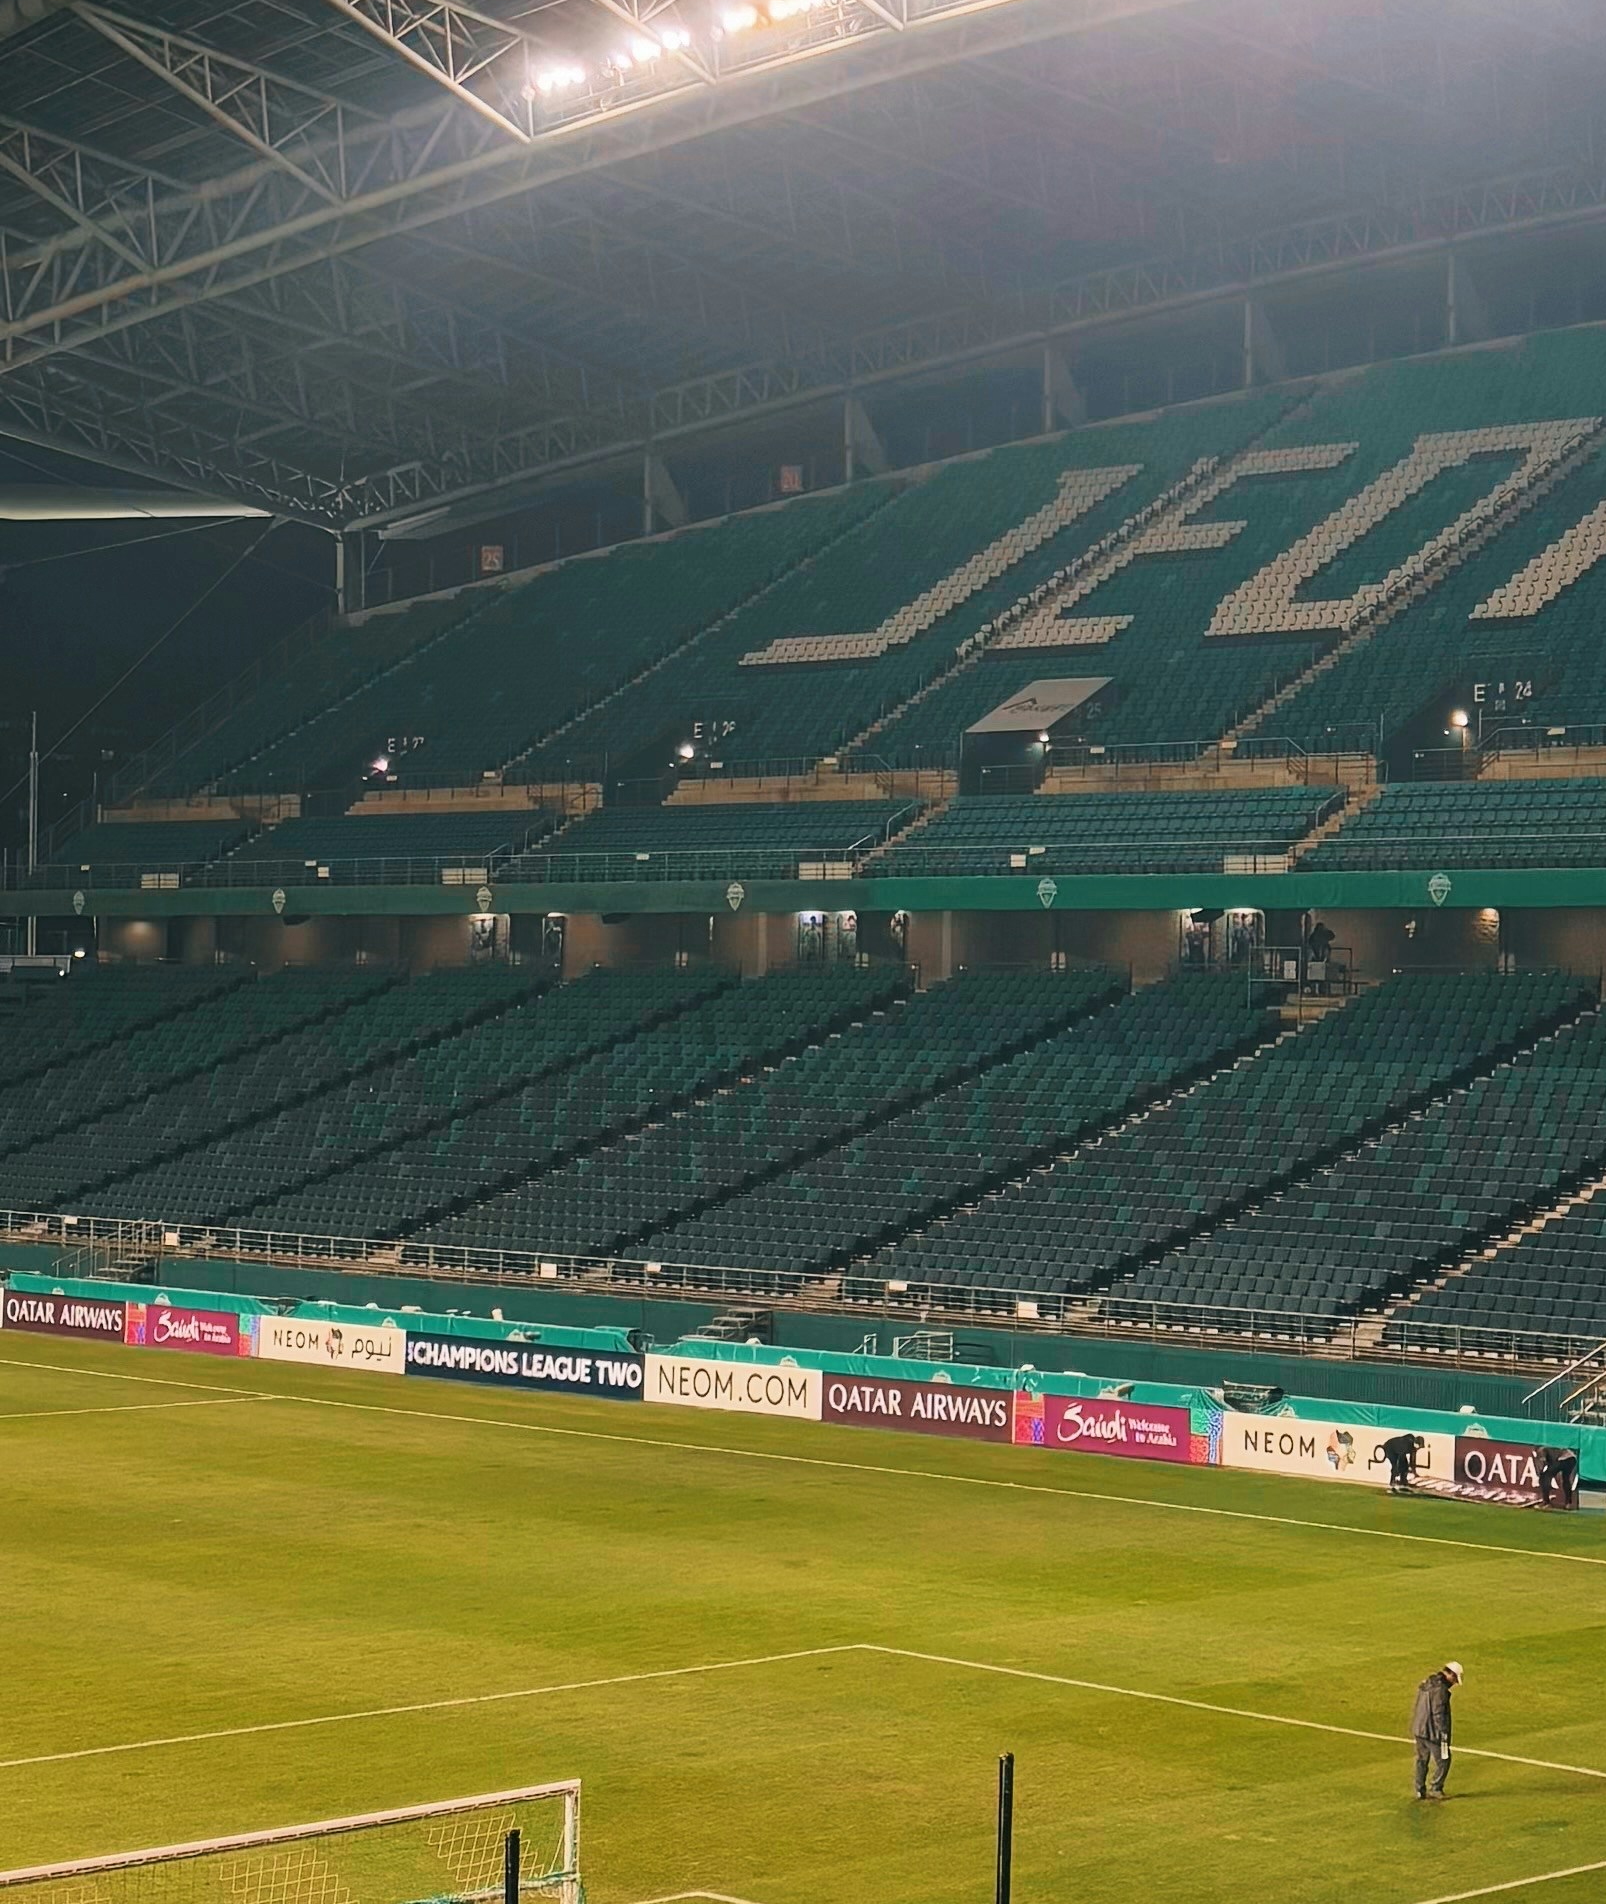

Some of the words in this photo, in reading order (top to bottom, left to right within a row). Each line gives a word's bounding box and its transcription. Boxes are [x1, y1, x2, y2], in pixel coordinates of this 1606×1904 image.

[1474, 684, 1486, 702] E
[387, 738, 396, 753] E
[693, 722, 703, 739] E
[6, 1299, 55, 1324] QATAR
[60, 1304, 123, 1331] AIRWAYS
[153, 1309, 200, 1343] Saudi
[273, 1329, 319, 1349] NEOM
[352, 1337, 392, 1361] نيوم
[413, 1341, 518, 1375] CHAMPIONS
[522, 1353, 592, 1384] LEAGUE
[596, 1361, 643, 1388] TWO
[658, 1365, 808, 1408] NEOM.COM
[829, 1383, 902, 1415] QATAR
[911, 1392, 1007, 1426] AIRWAYS
[1057, 1402, 1127, 1443] Saudi
[1244, 1430, 1315, 1458] NEOM
[1464, 1450, 1558, 1490] QATA
